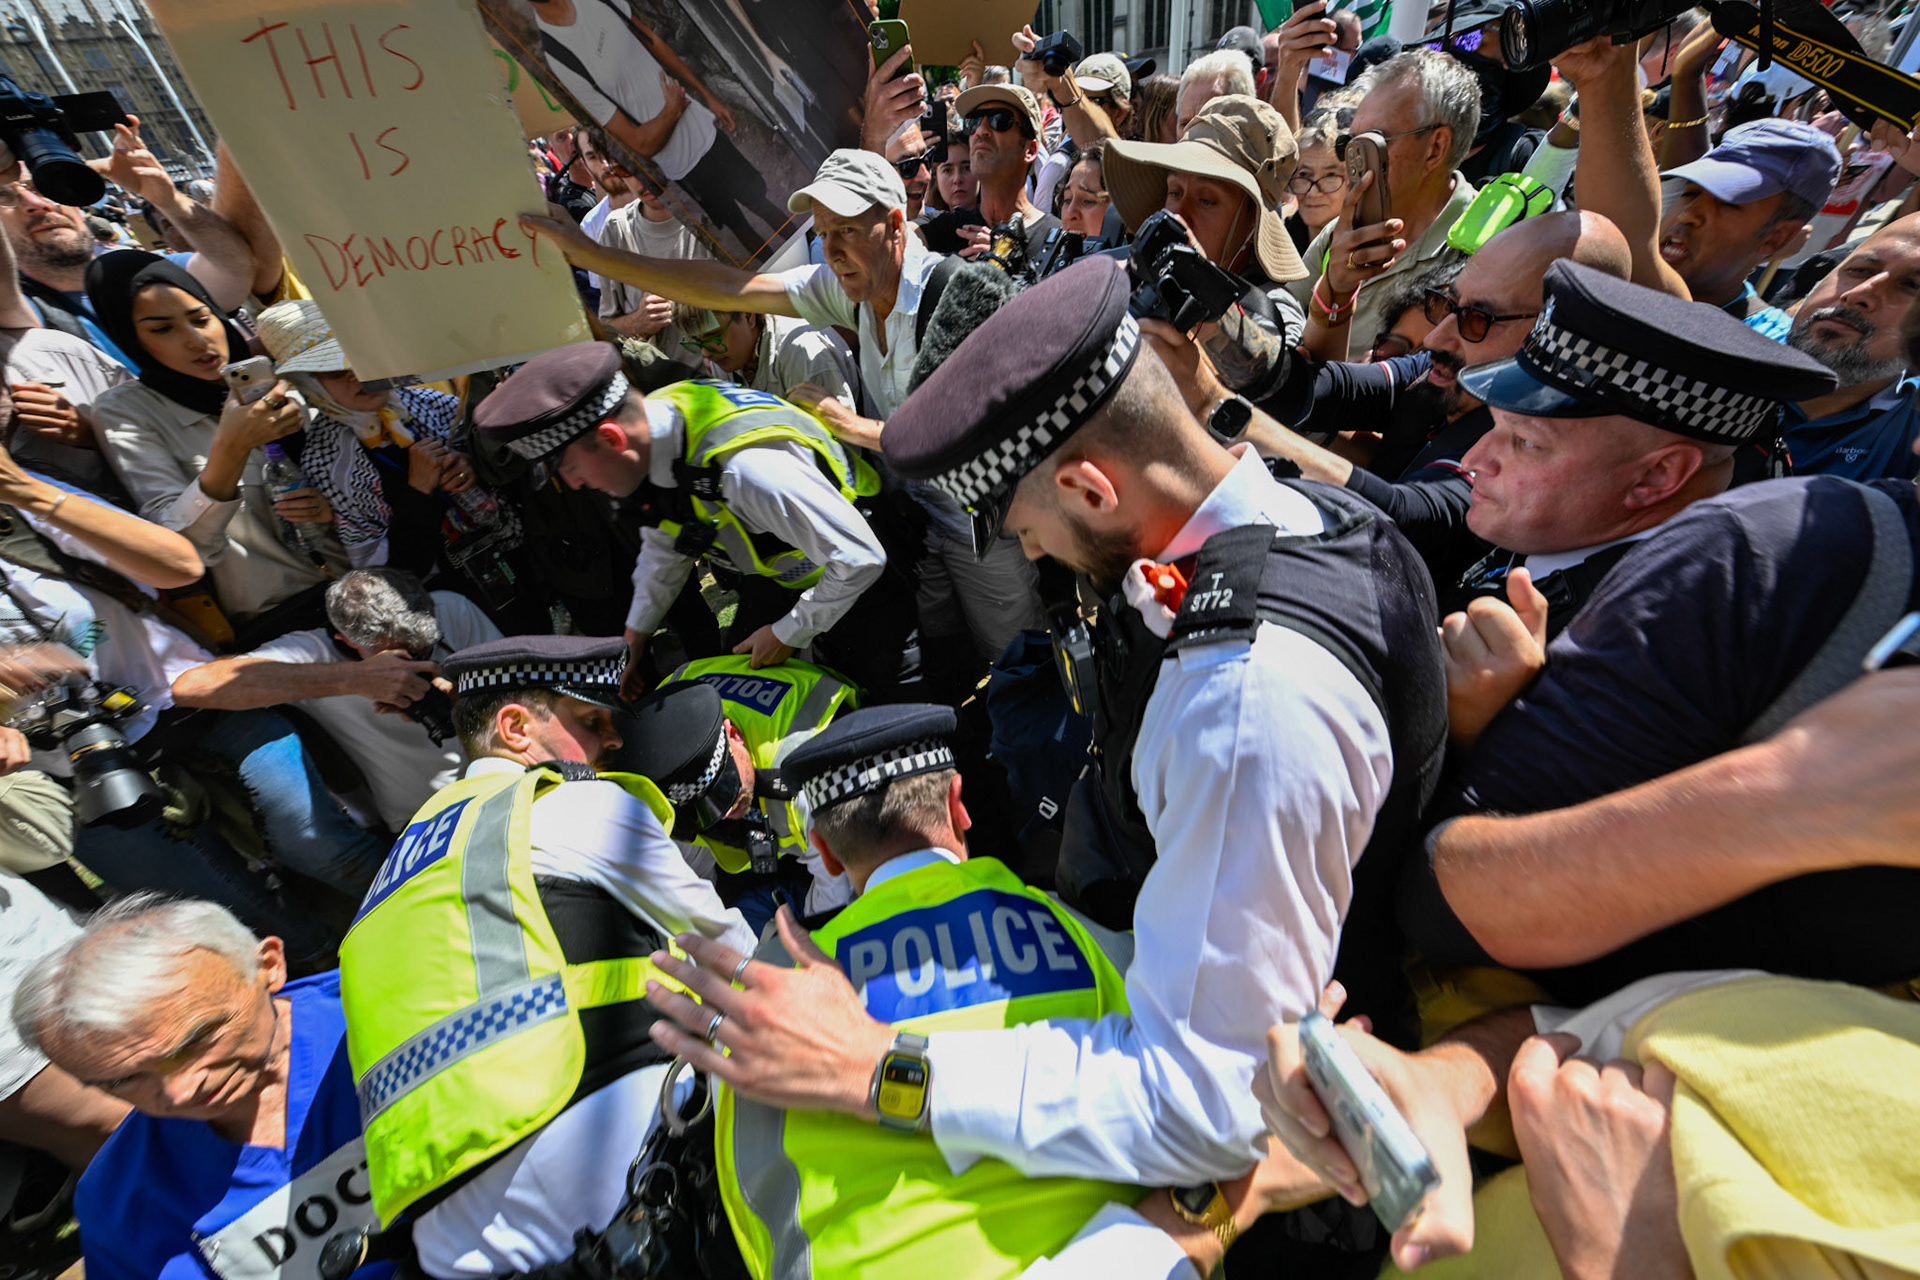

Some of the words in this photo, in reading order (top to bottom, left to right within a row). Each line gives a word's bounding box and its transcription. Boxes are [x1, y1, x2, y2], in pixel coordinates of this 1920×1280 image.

[241, 17, 424, 110] THIS
[1747, 23, 1790, 50] Non
[1786, 40, 1845, 78] D500
[349, 127, 410, 180] IS
[304, 217, 551, 292] DEMOCRACY
[1211, 572, 1224, 590] T
[700, 676, 783, 708] POLI
[849, 906, 1078, 1009] POLICE
